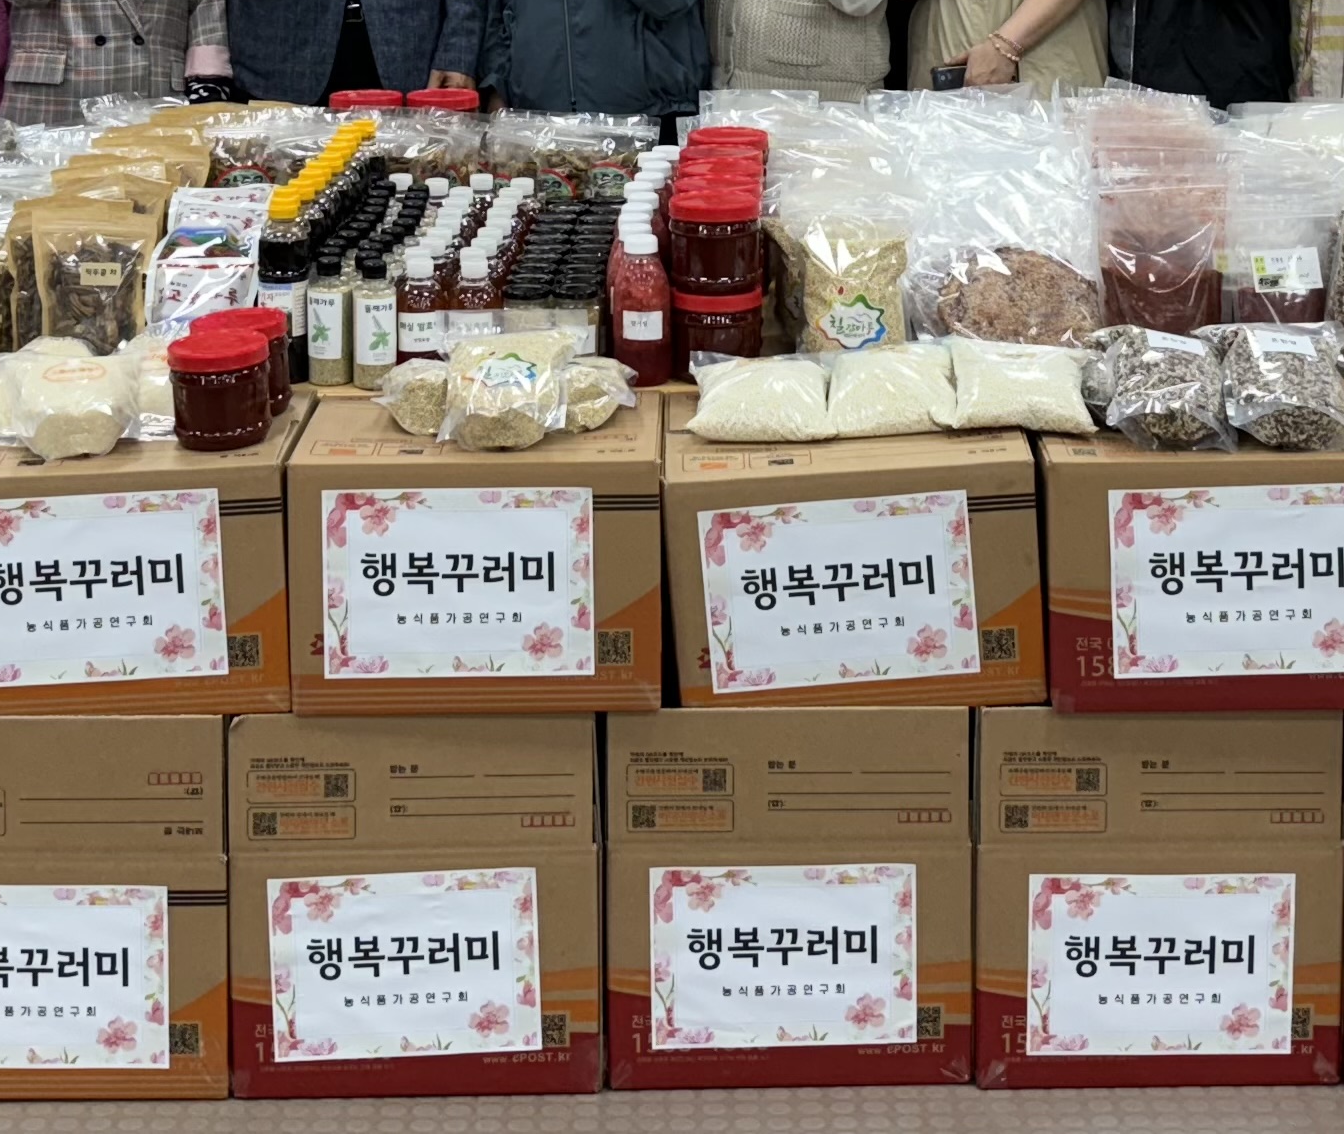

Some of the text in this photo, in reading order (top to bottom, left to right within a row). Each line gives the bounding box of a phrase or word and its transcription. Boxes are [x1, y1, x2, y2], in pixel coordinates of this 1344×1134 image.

[360, 551, 555, 597] 행복꾸러미
[740, 554, 936, 611] 행복꾸러미
[1148, 546, 1344, 596] 행복꾸러미
[306, 930, 500, 981] 행복꾸러미
[686, 925, 878, 971] 행복꾸러미
[1064, 934, 1255, 978] 행복꾸러미
